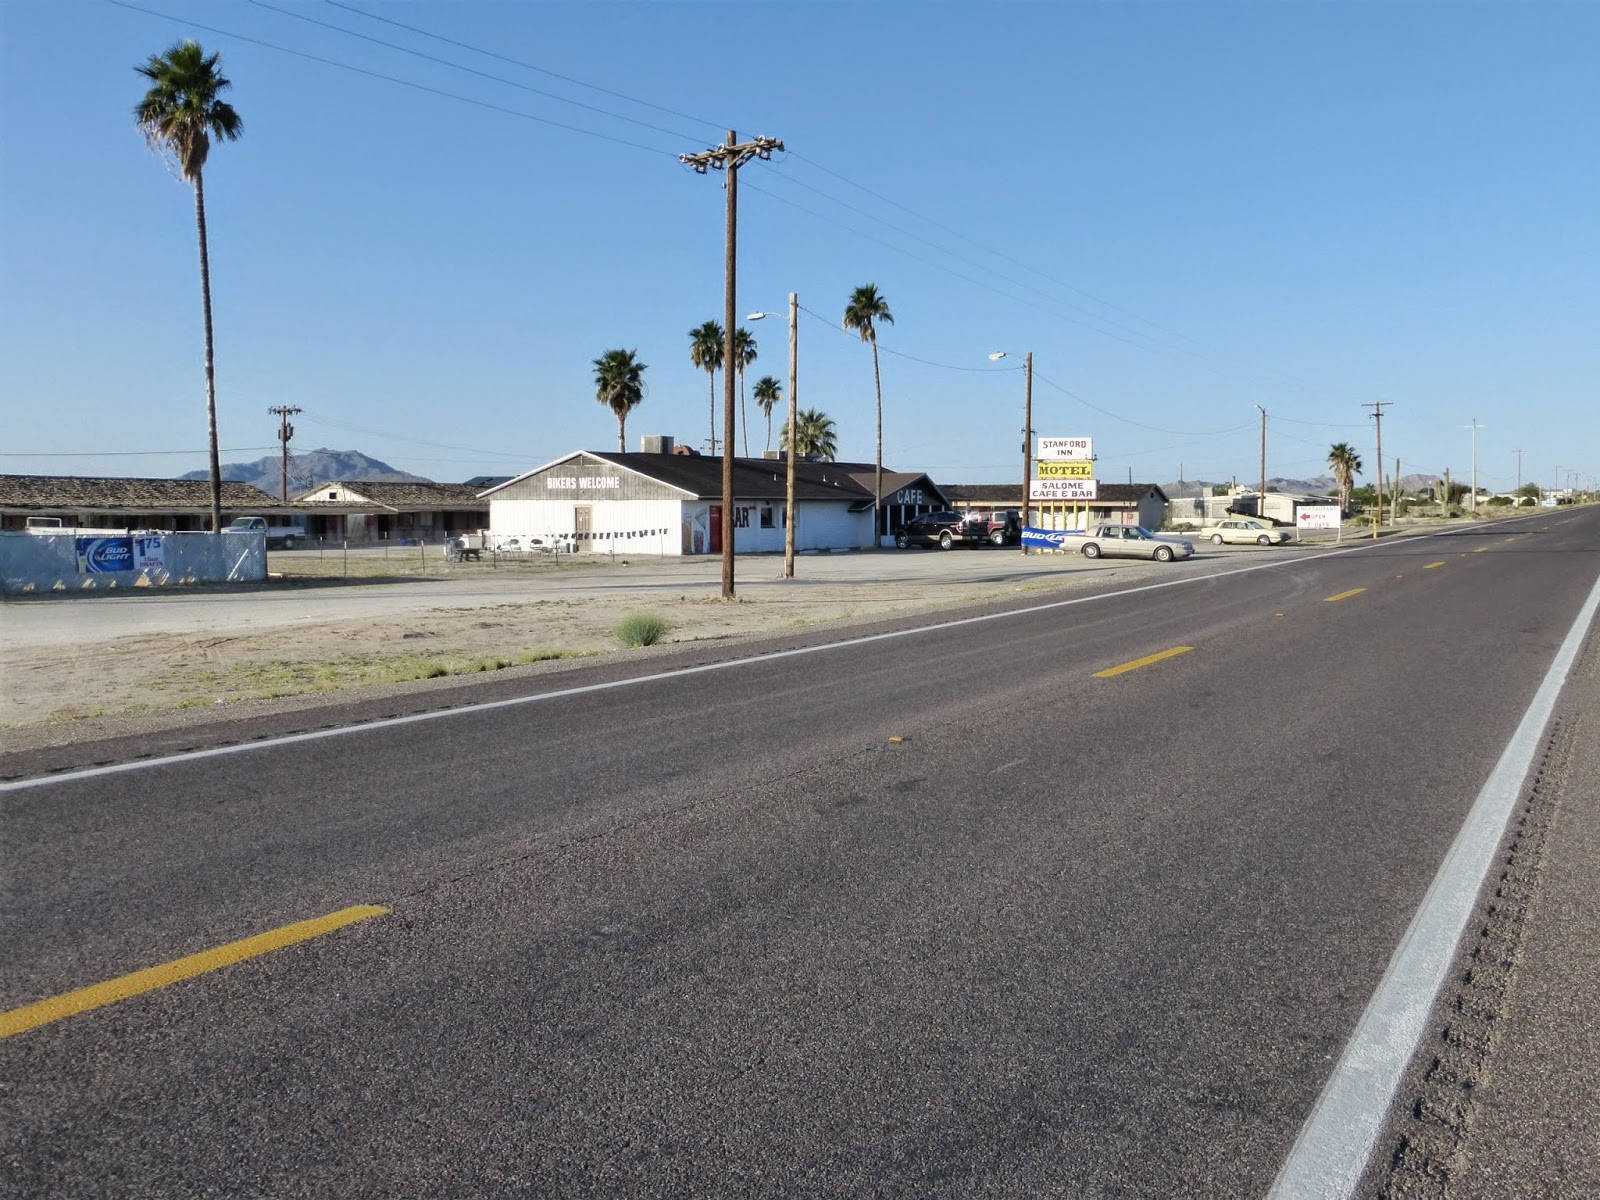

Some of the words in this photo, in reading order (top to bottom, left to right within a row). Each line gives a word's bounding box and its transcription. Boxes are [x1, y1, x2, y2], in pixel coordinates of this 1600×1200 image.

[1043, 440, 1087, 448] STANFORD
[1039, 466, 1091, 475] MOTEL
[547, 477, 577, 489] BIKERS
[579, 476, 620, 489] WELCOME
[896, 489, 923, 504] CAFE
[733, 506, 750, 528] AR
[1021, 531, 1046, 540] BUD
